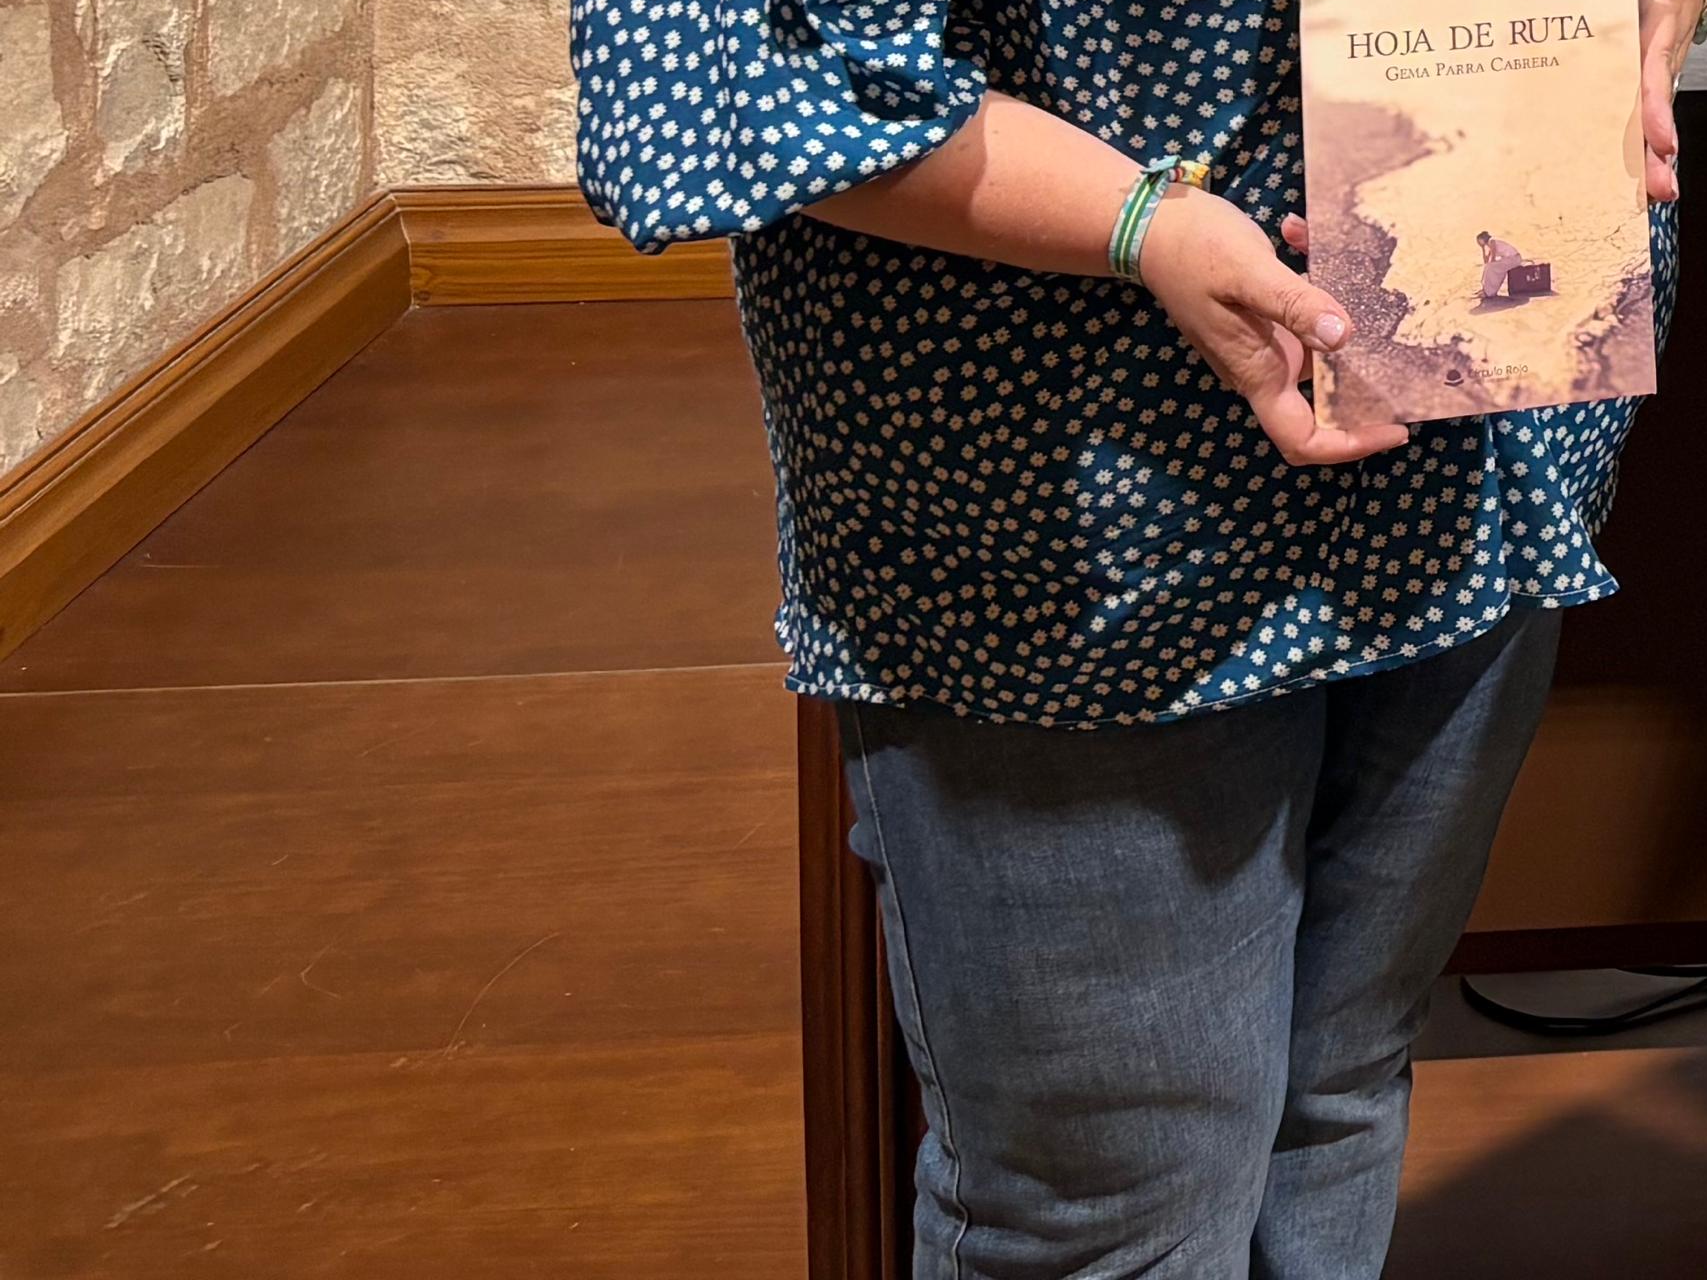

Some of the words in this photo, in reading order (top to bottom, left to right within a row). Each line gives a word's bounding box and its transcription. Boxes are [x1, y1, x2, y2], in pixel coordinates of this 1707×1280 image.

[1347, 29, 1434, 59] HOJA
[1449, 22, 1494, 50] DE
[1509, 15, 1594, 45] RUTA
